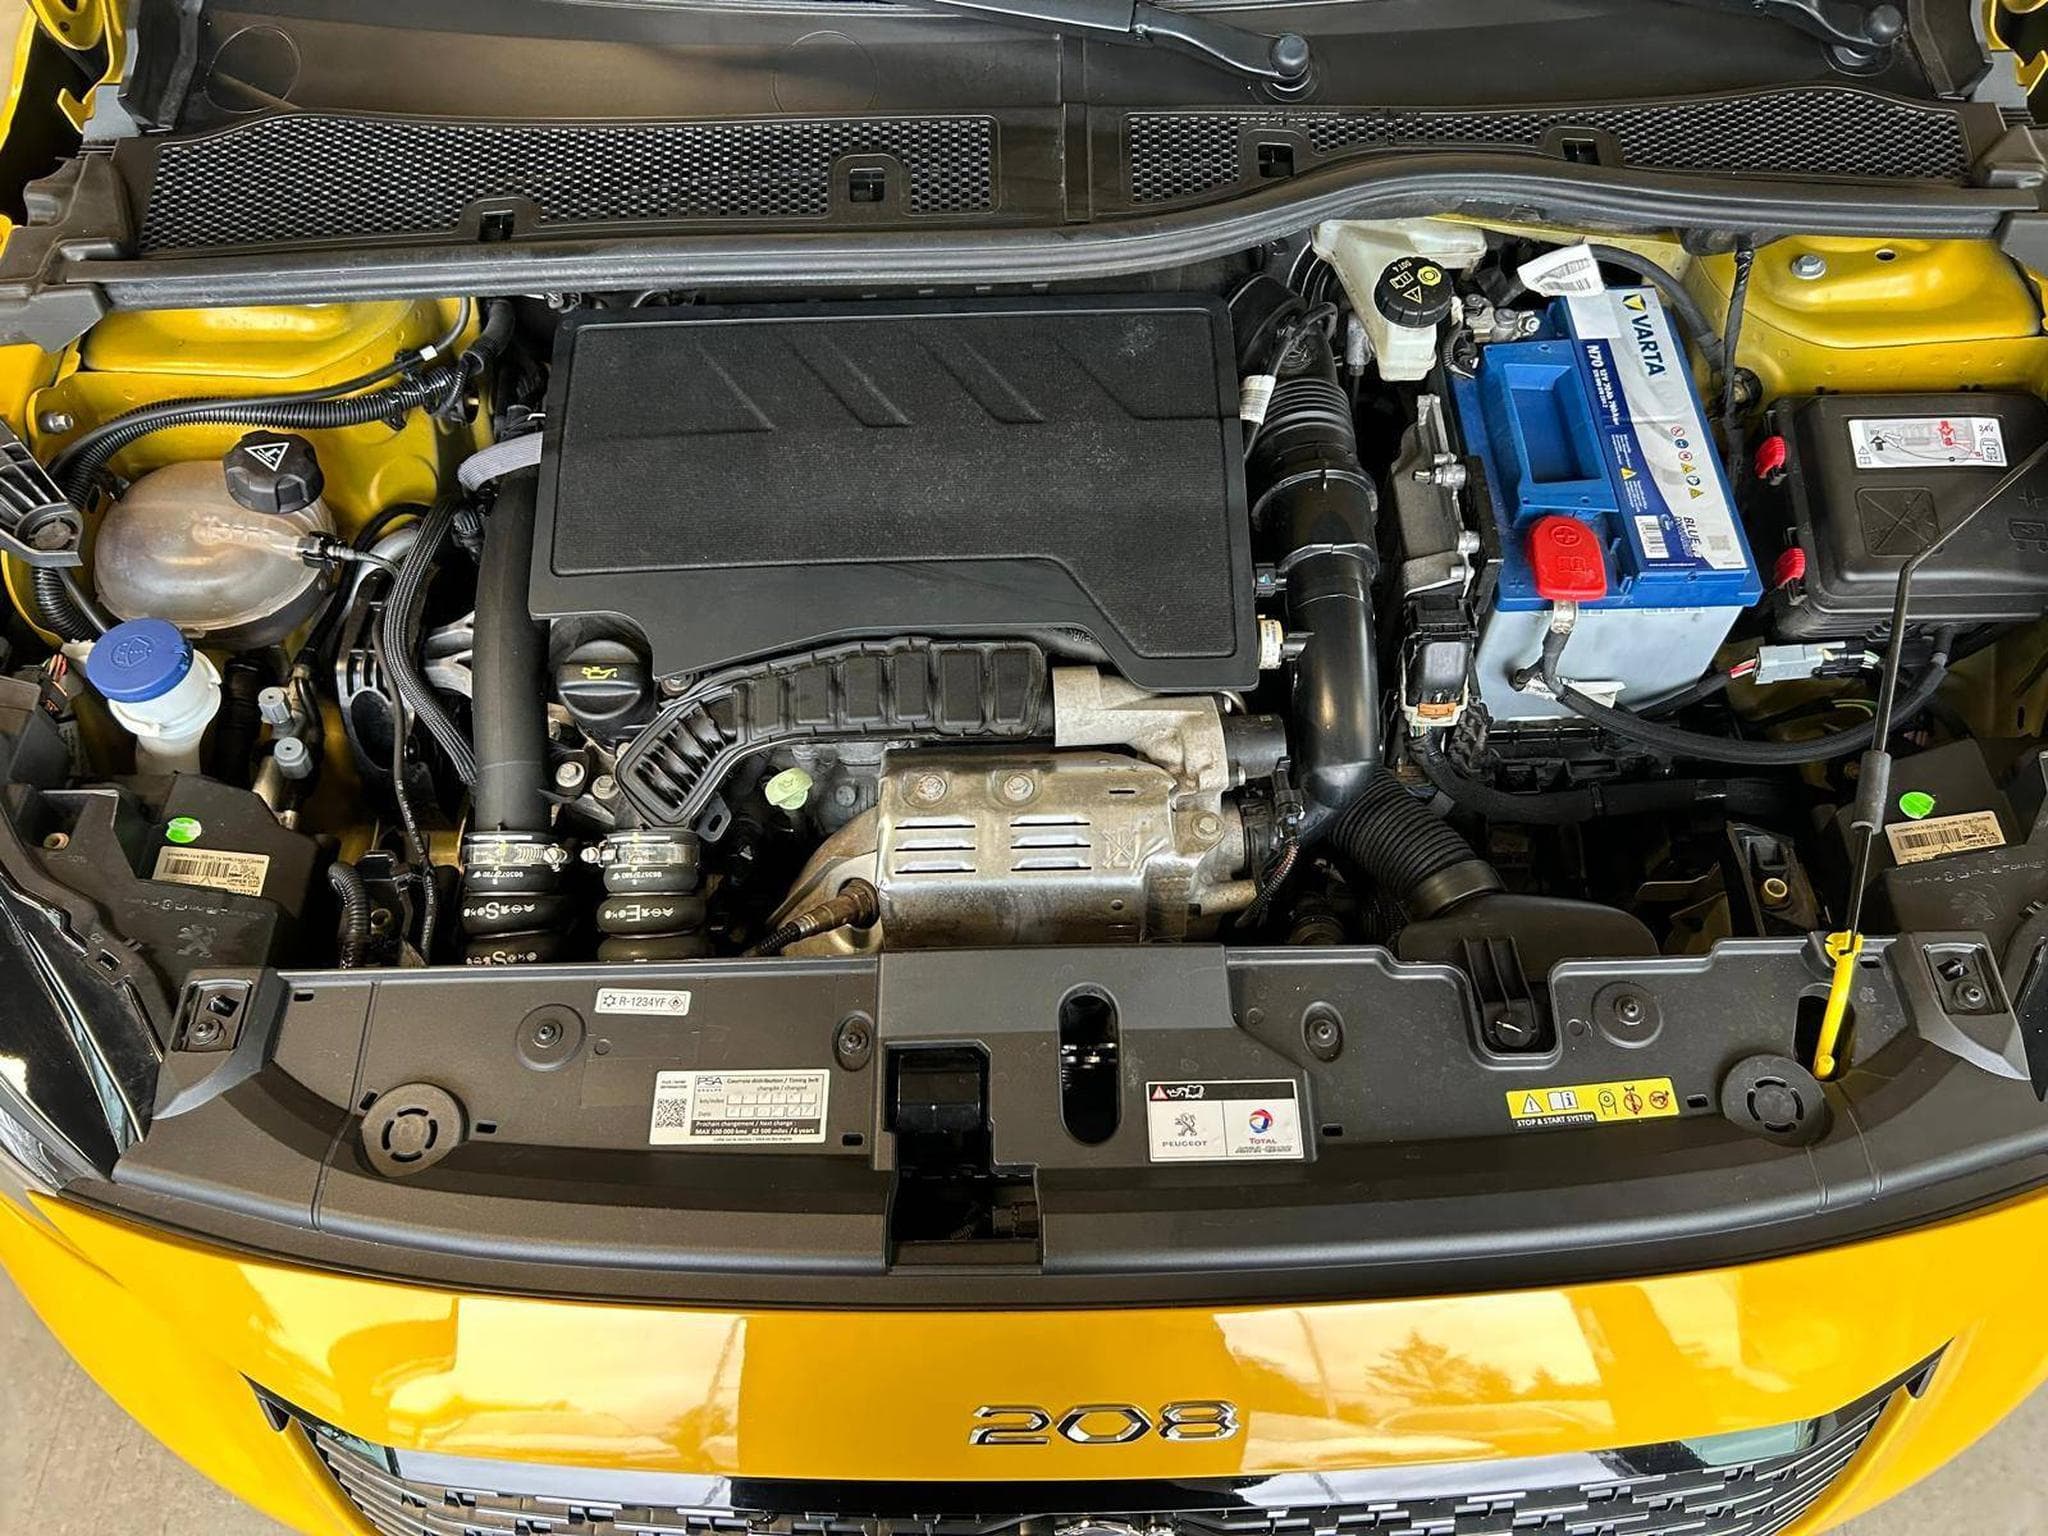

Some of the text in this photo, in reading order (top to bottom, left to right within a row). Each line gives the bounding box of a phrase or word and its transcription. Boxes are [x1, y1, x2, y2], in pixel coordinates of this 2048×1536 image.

[1631, 314, 1666, 376] VARTA
[1586, 345, 1604, 368] N70
[1683, 516, 1700, 545] BLUE
[625, 904, 641, 922] E
[618, 996, 666, 1007] R-1234YF
[697, 1076, 722, 1086] PSA
[1517, 1119, 1537, 1127] STOP
[1544, 1116, 1566, 1126] START
[1566, 1114, 1594, 1123] SYSTEM
[968, 1400, 1240, 1445] 208
